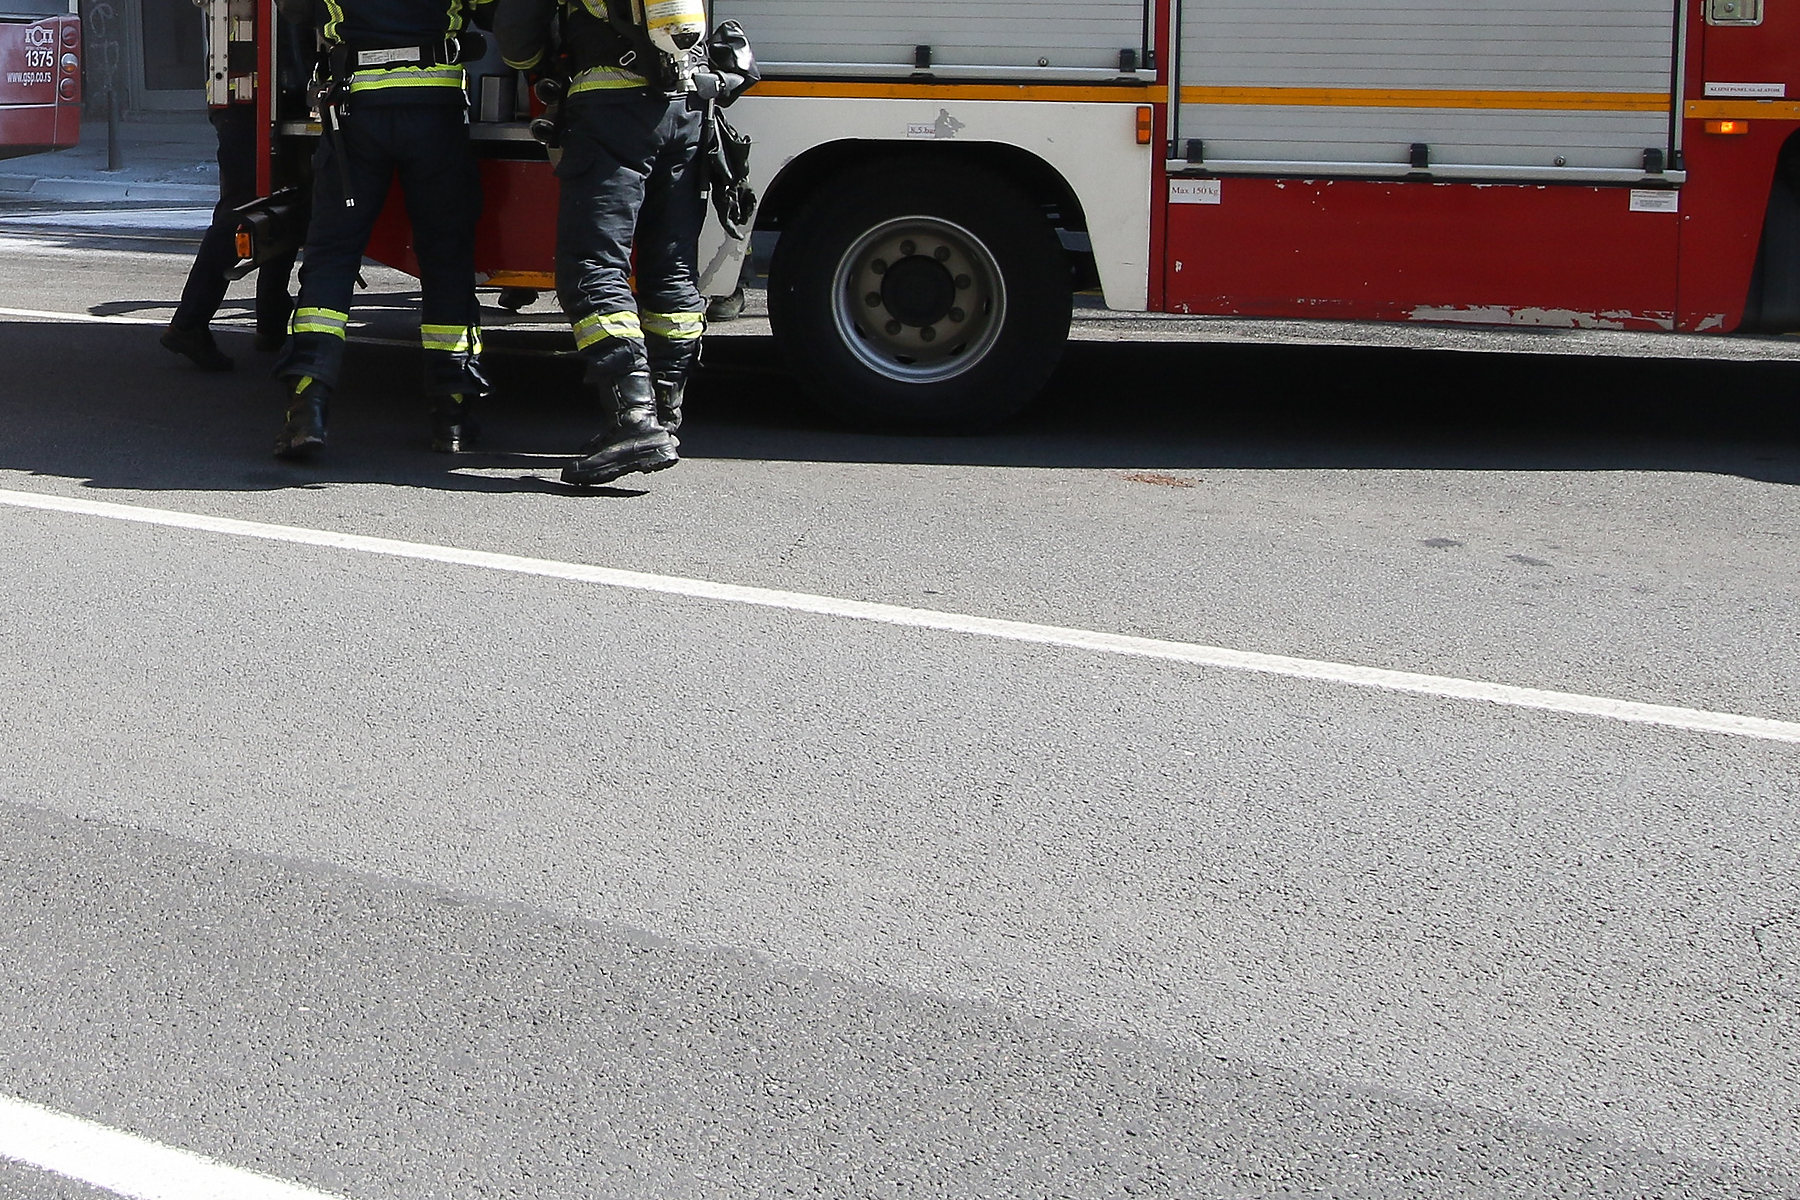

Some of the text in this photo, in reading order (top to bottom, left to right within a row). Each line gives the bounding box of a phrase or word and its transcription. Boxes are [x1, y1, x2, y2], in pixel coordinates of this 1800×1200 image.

[25, 50, 54, 67] 1375
[7, 72, 52, 86] www.gsp.co.rs
[1172, 186, 1189, 194] Max
[1209, 187, 1218, 197] kg
